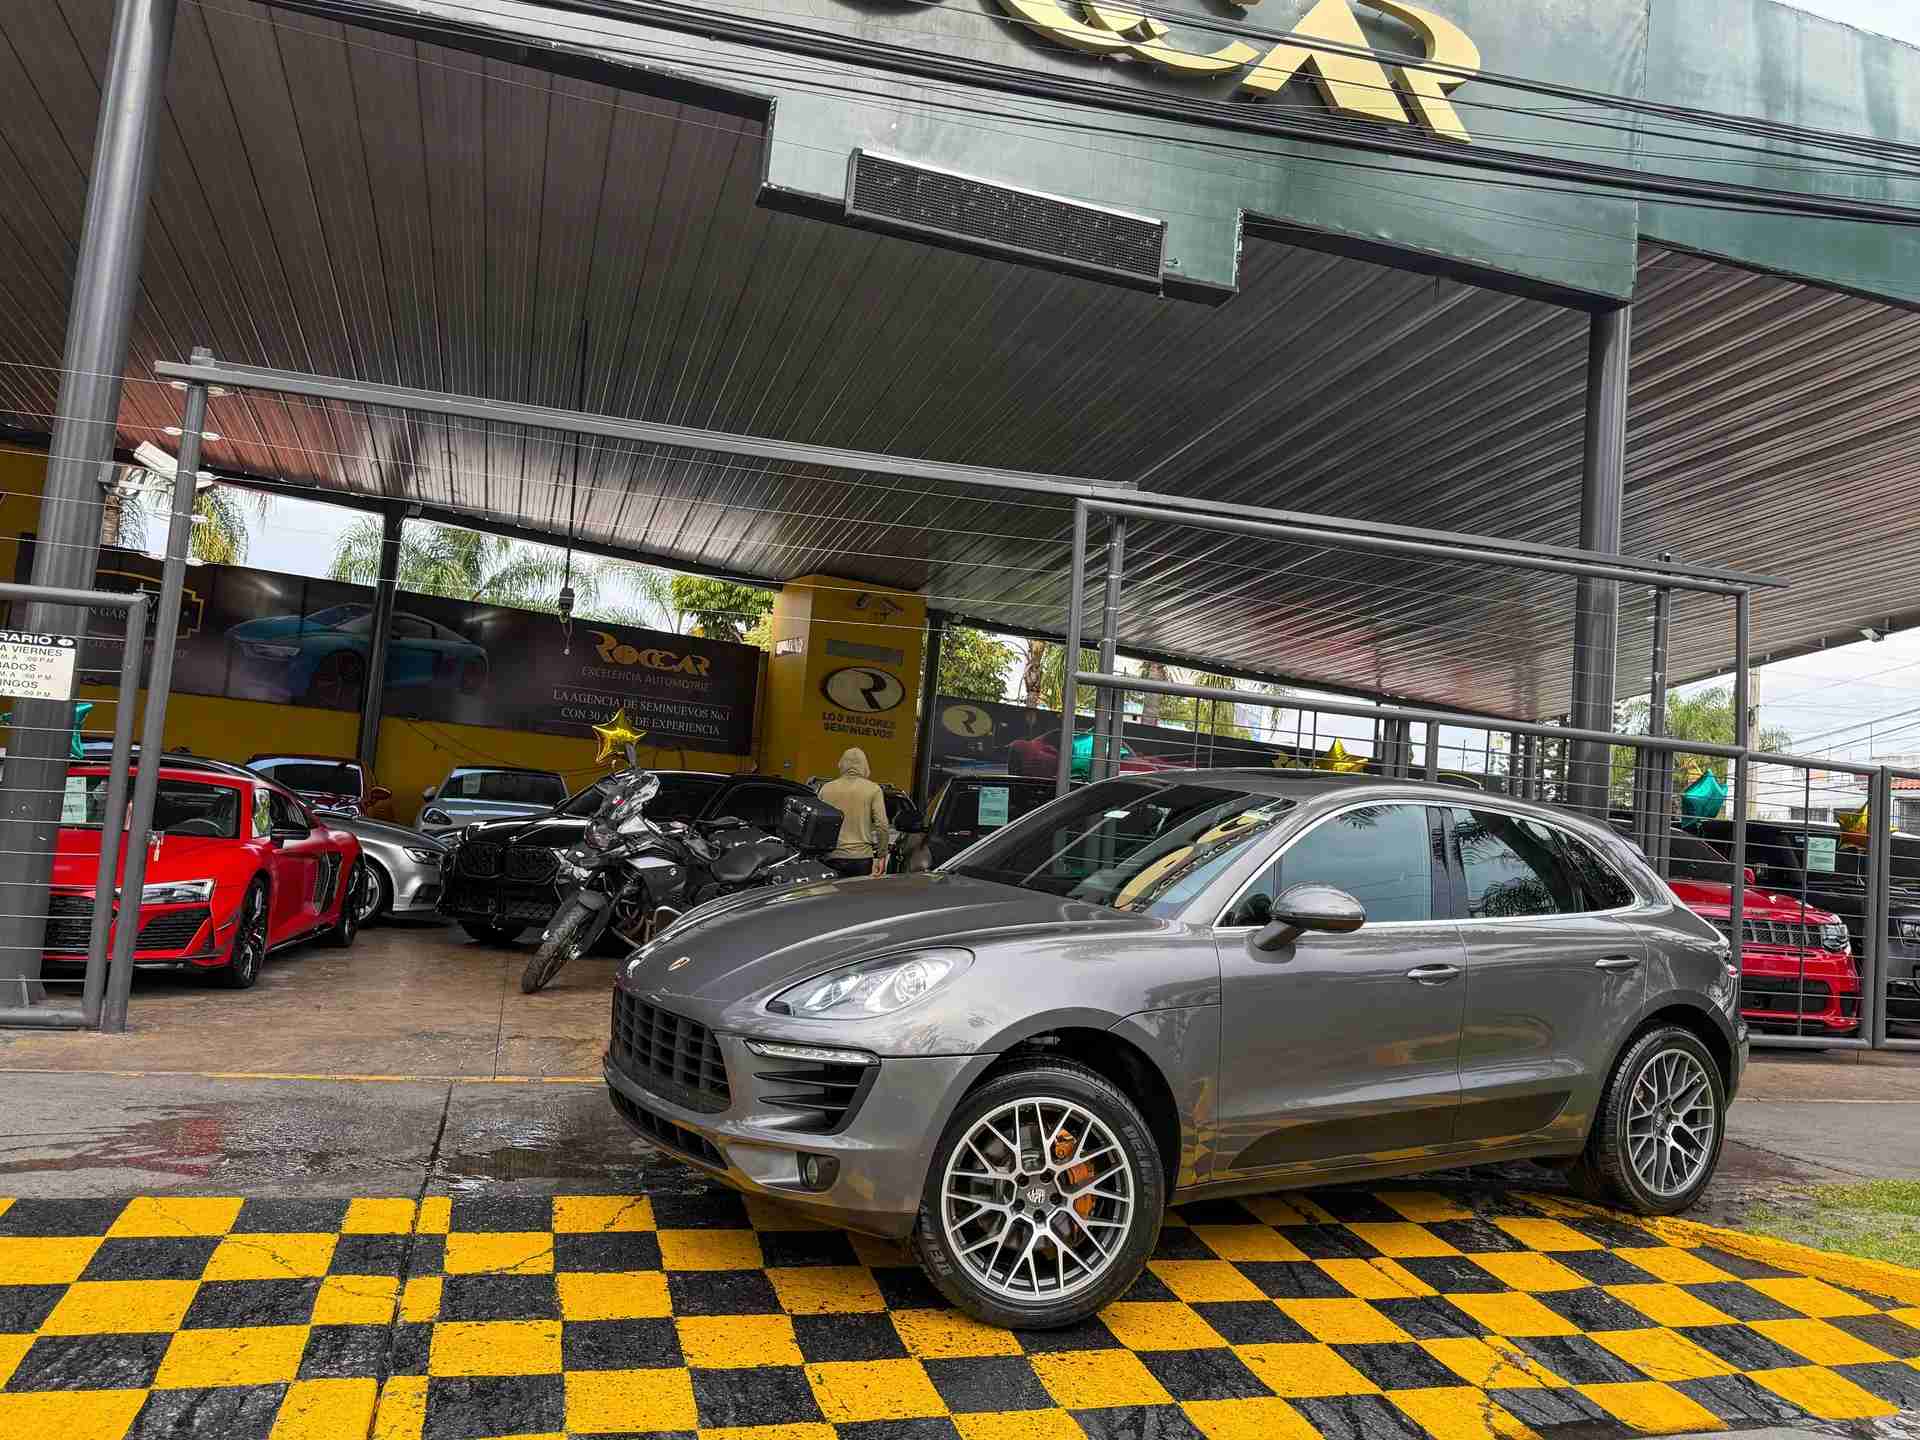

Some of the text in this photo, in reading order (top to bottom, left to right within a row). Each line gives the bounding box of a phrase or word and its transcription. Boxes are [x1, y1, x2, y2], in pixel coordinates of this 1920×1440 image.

[12, 645, 63, 657] VIERNES
[586, 630, 712, 677] ROCCAR
[0, 662, 37, 672] ADOS
[570, 692, 620, 706] AGENCIA
[640, 701, 708, 719] SEMINUEVOS
[561, 707, 586, 720] CON
[652, 718, 721, 736] EXPERIENCIA
